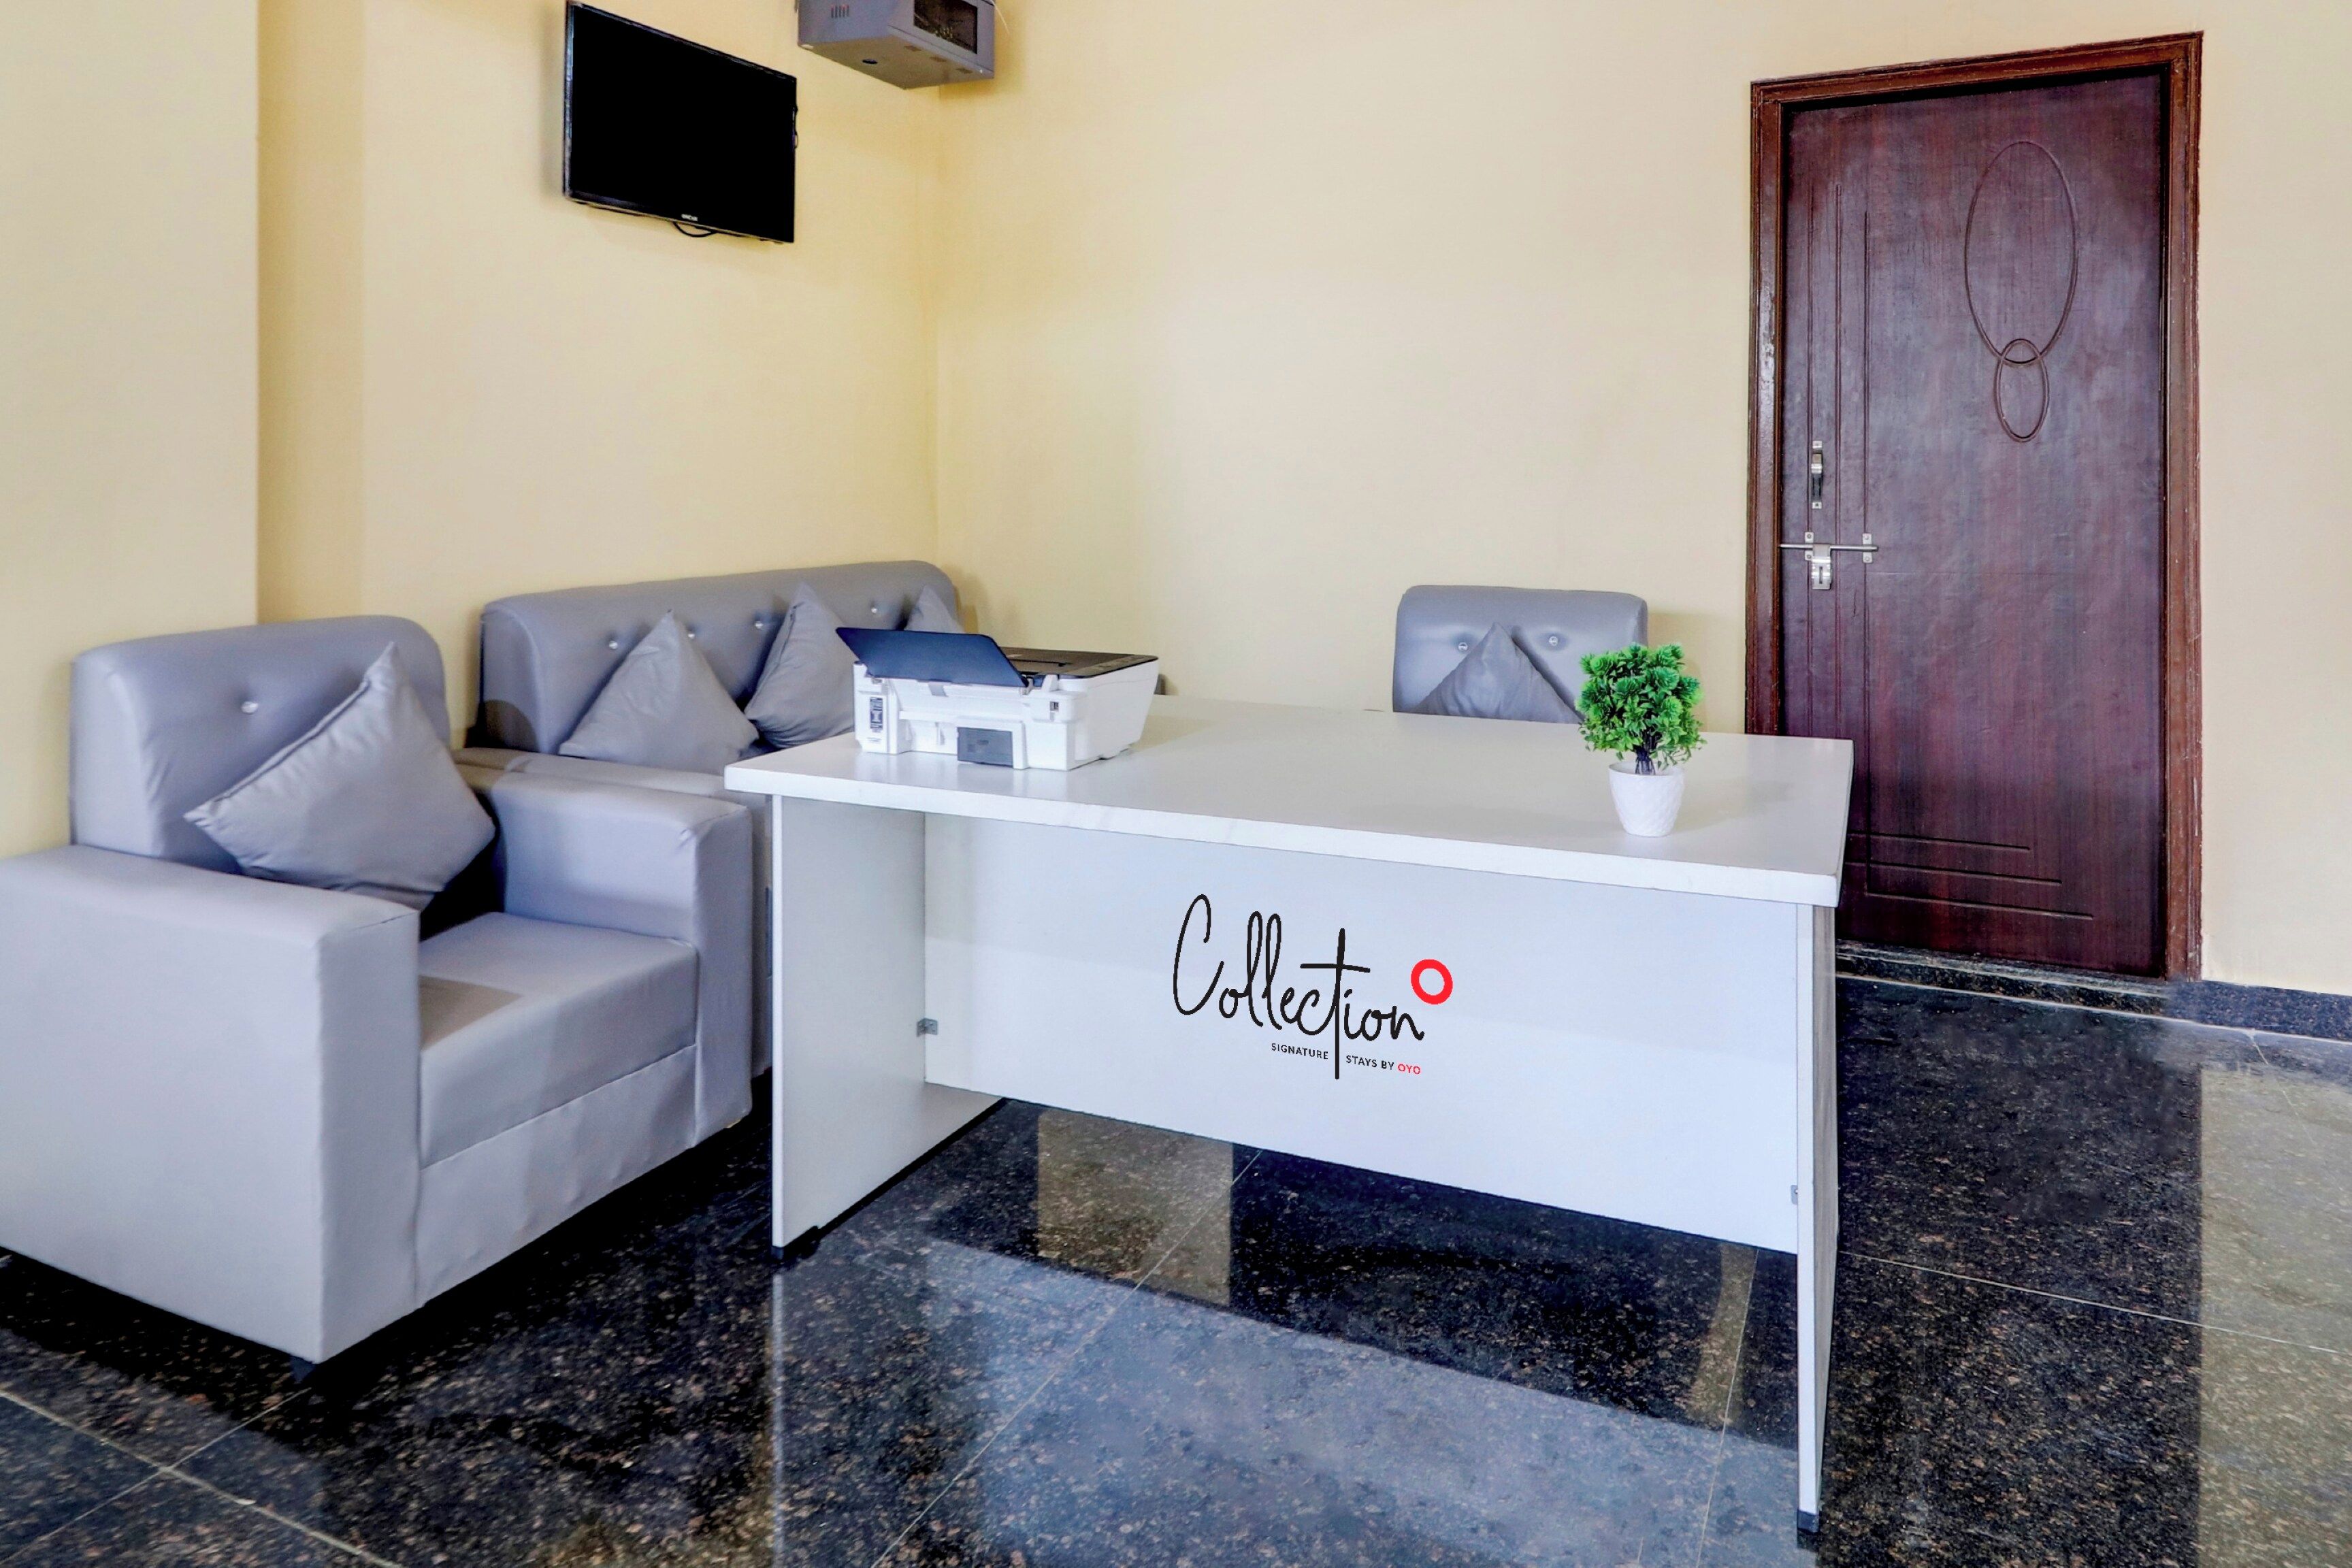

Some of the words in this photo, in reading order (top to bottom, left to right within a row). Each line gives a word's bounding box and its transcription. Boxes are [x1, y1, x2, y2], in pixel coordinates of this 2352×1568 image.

[1173, 894, 1425, 1080] Collection
[1271, 1043, 1328, 1060] SIGNATURE
[1345, 1054, 1377, 1068] STAYS
[1381, 1060, 1394, 1071] BY
[1397, 1063, 1422, 1075] OYO
